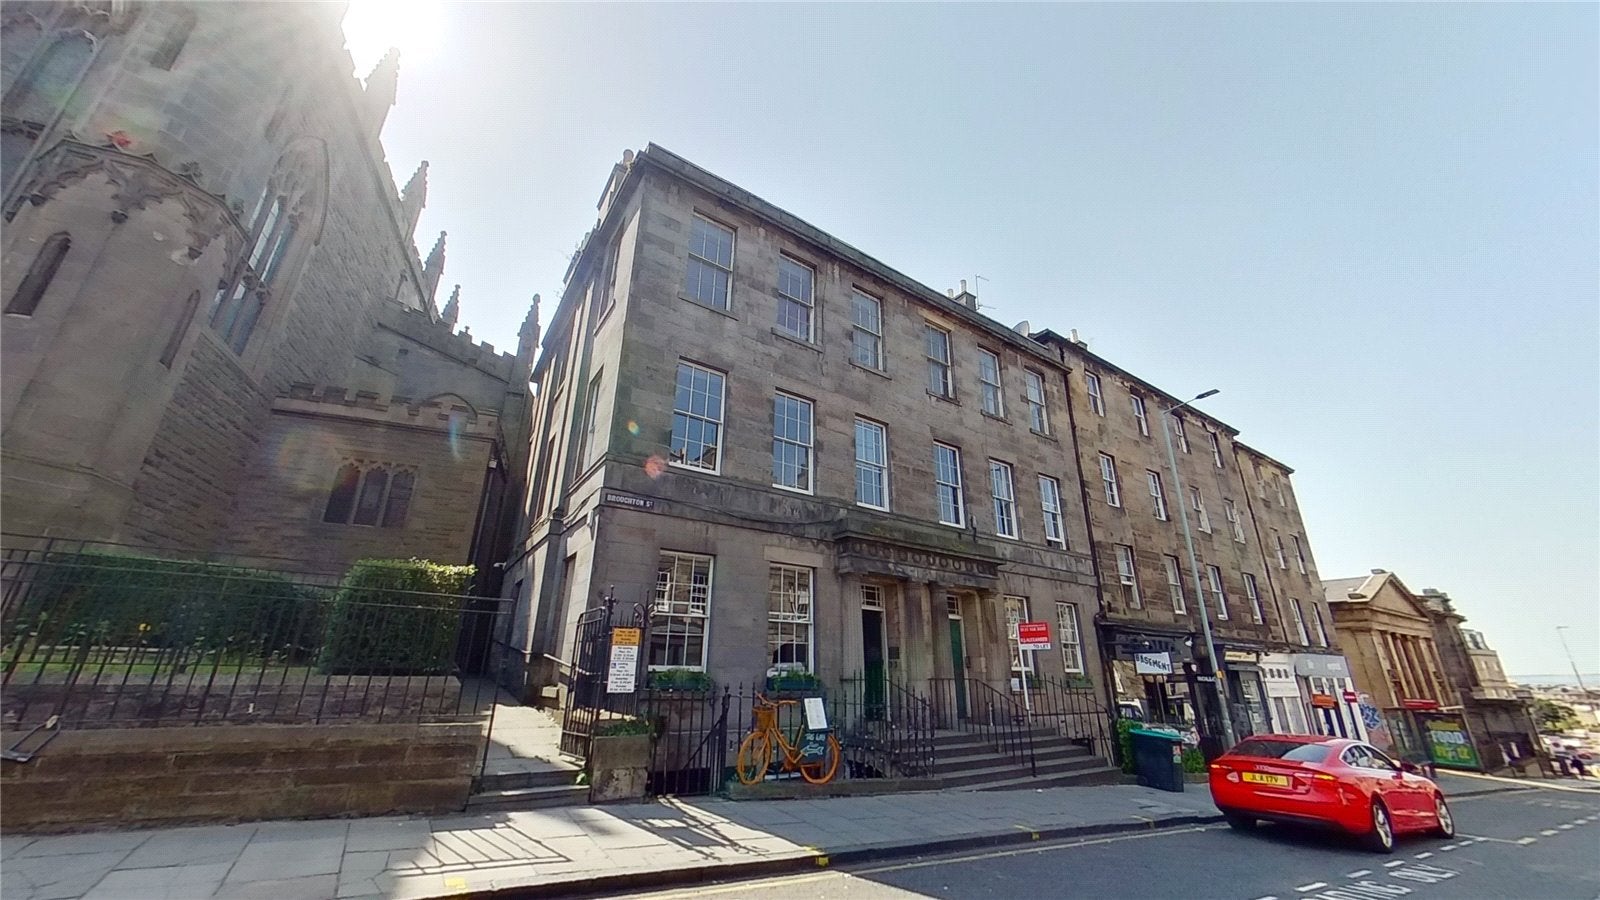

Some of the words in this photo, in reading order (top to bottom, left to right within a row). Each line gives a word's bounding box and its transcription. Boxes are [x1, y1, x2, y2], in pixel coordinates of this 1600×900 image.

[607, 494, 645, 506] BROUGHTON
[1135, 654, 1171, 672] BASEMENT
[1430, 730, 1465, 744] FOOD
